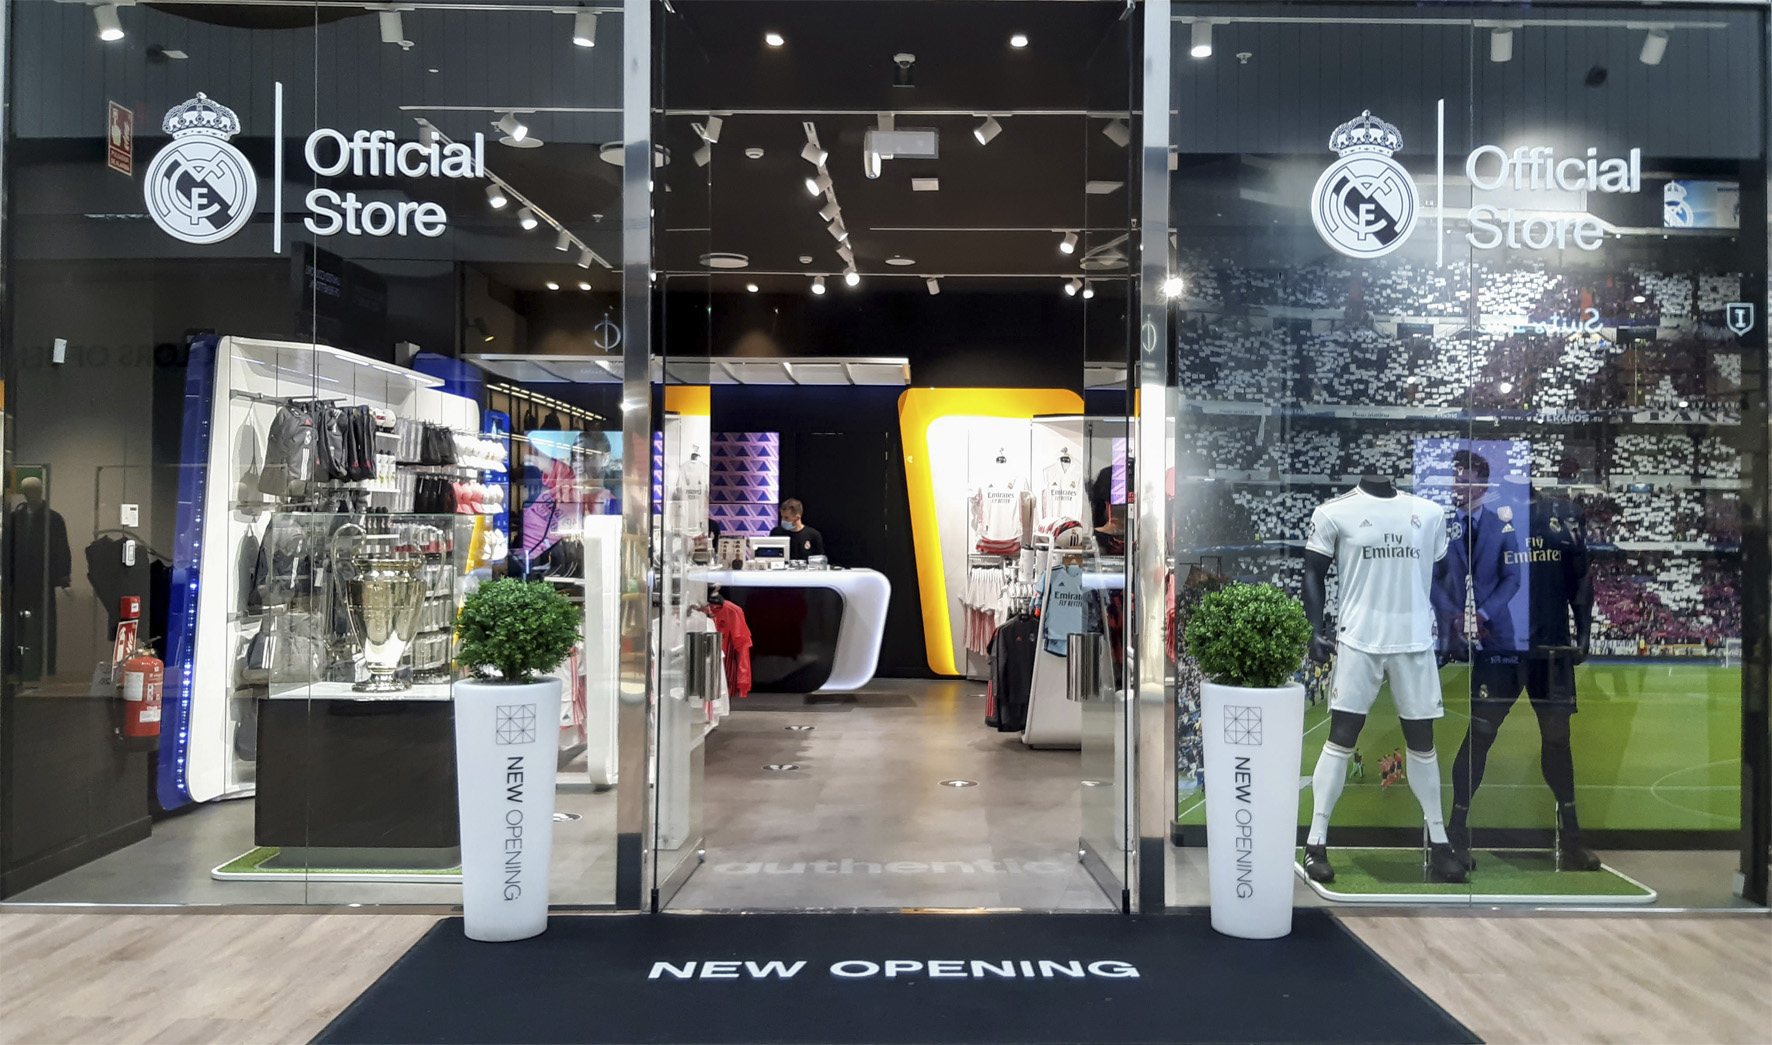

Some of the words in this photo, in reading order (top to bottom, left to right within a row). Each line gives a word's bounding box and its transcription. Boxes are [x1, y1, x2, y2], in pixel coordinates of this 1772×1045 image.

[304, 128, 485, 178] Official
[1465, 144, 1641, 193] Official
[303, 188, 447, 237] Store
[1465, 204, 1604, 251] Store
[1362, 544, 1420, 560] Emirates
[1384, 533, 1402, 544] Fly
[1525, 536, 1544, 549] Fly
[506, 756, 524, 803] NEW
[1235, 756, 1252, 803] NEW
[503, 809, 523, 901] OPENING
[1235, 809, 1253, 899] OPENING
[648, 961, 806, 979] NEW
[829, 960, 1141, 978] OPENING
